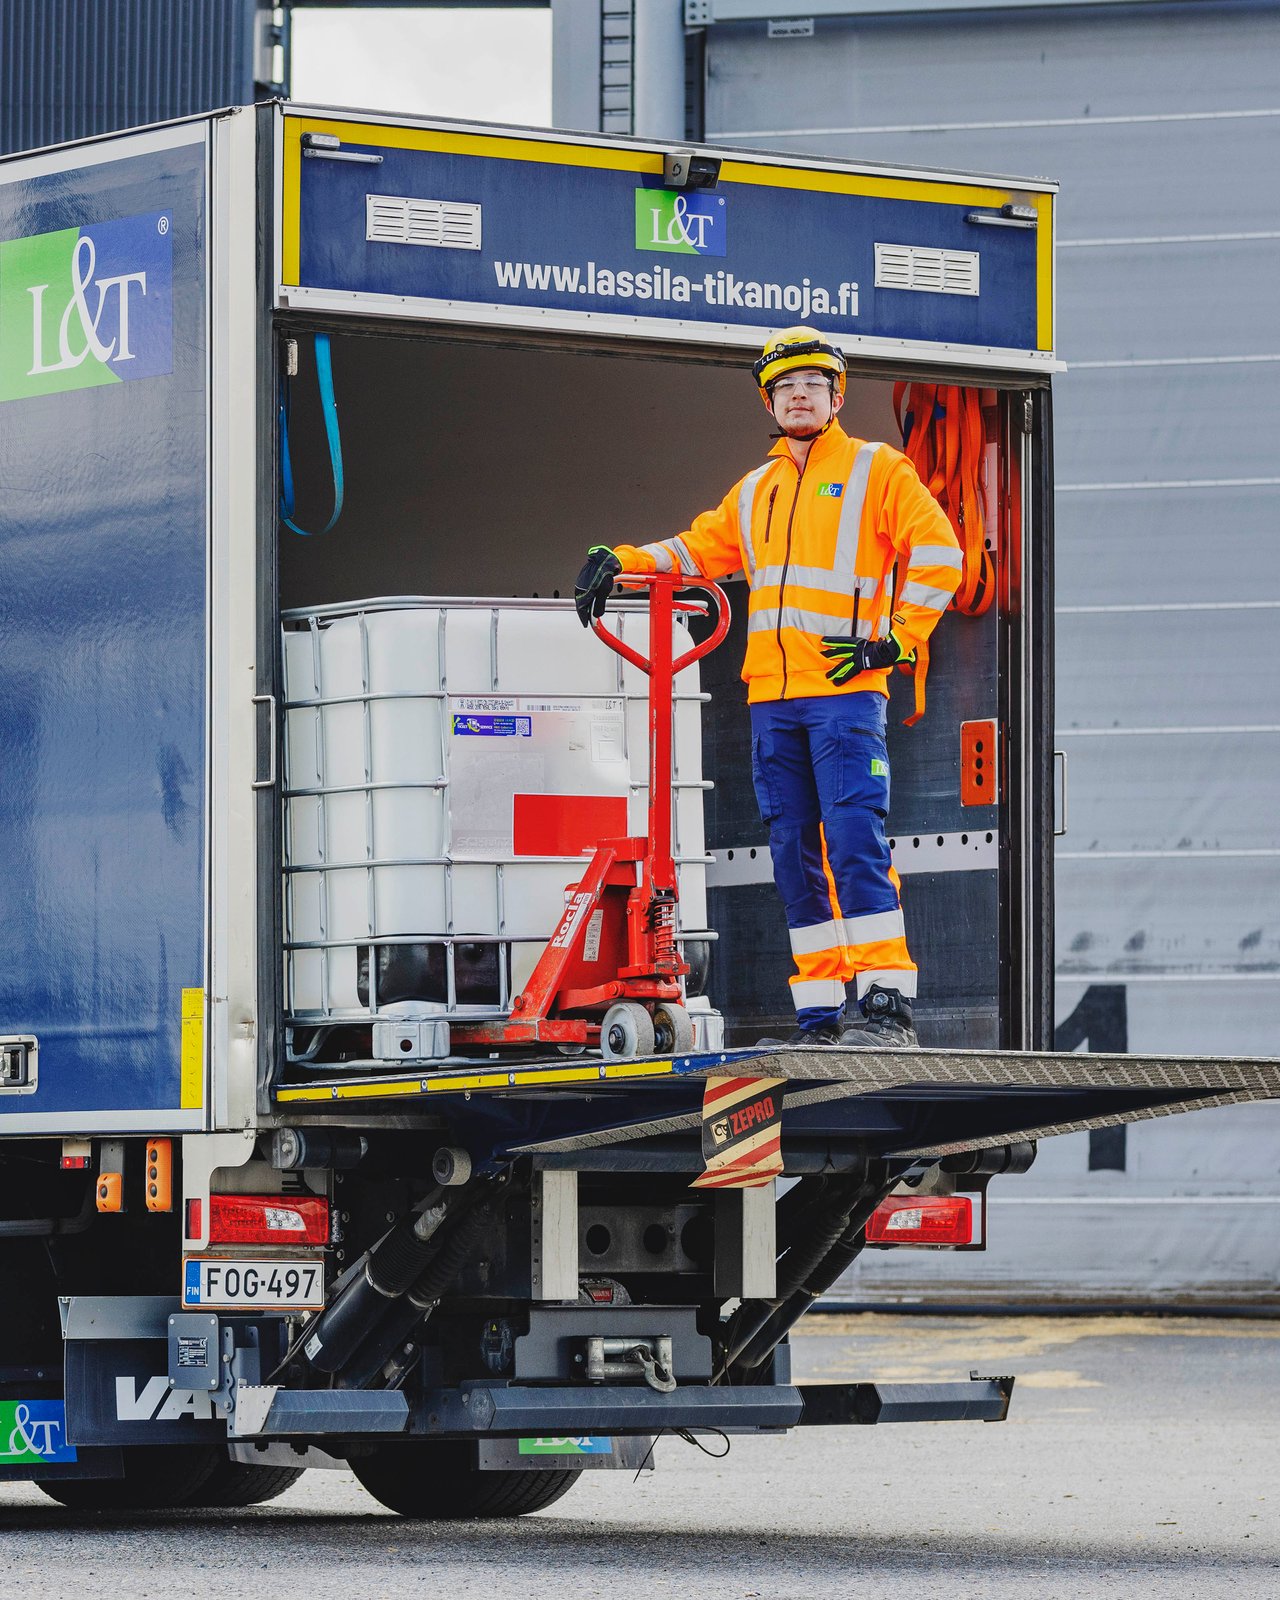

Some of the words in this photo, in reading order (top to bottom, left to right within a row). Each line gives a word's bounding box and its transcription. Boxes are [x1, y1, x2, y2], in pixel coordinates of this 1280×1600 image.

[650, 195, 714, 248] L&T
[27, 236, 147, 376] L&T
[494, 261, 859, 319] www.lassila-tikanoja.fi
[820, 483, 840, 496] L&T
[551, 892, 584, 947] Rocla
[730, 1096, 775, 1136] ZEPRO
[186, 1286, 200, 1296] FIN
[207, 1268, 316, 1298] FOG-497
[115, 1376, 228, 1420] VA
[0, 1404, 60, 1455] &T
